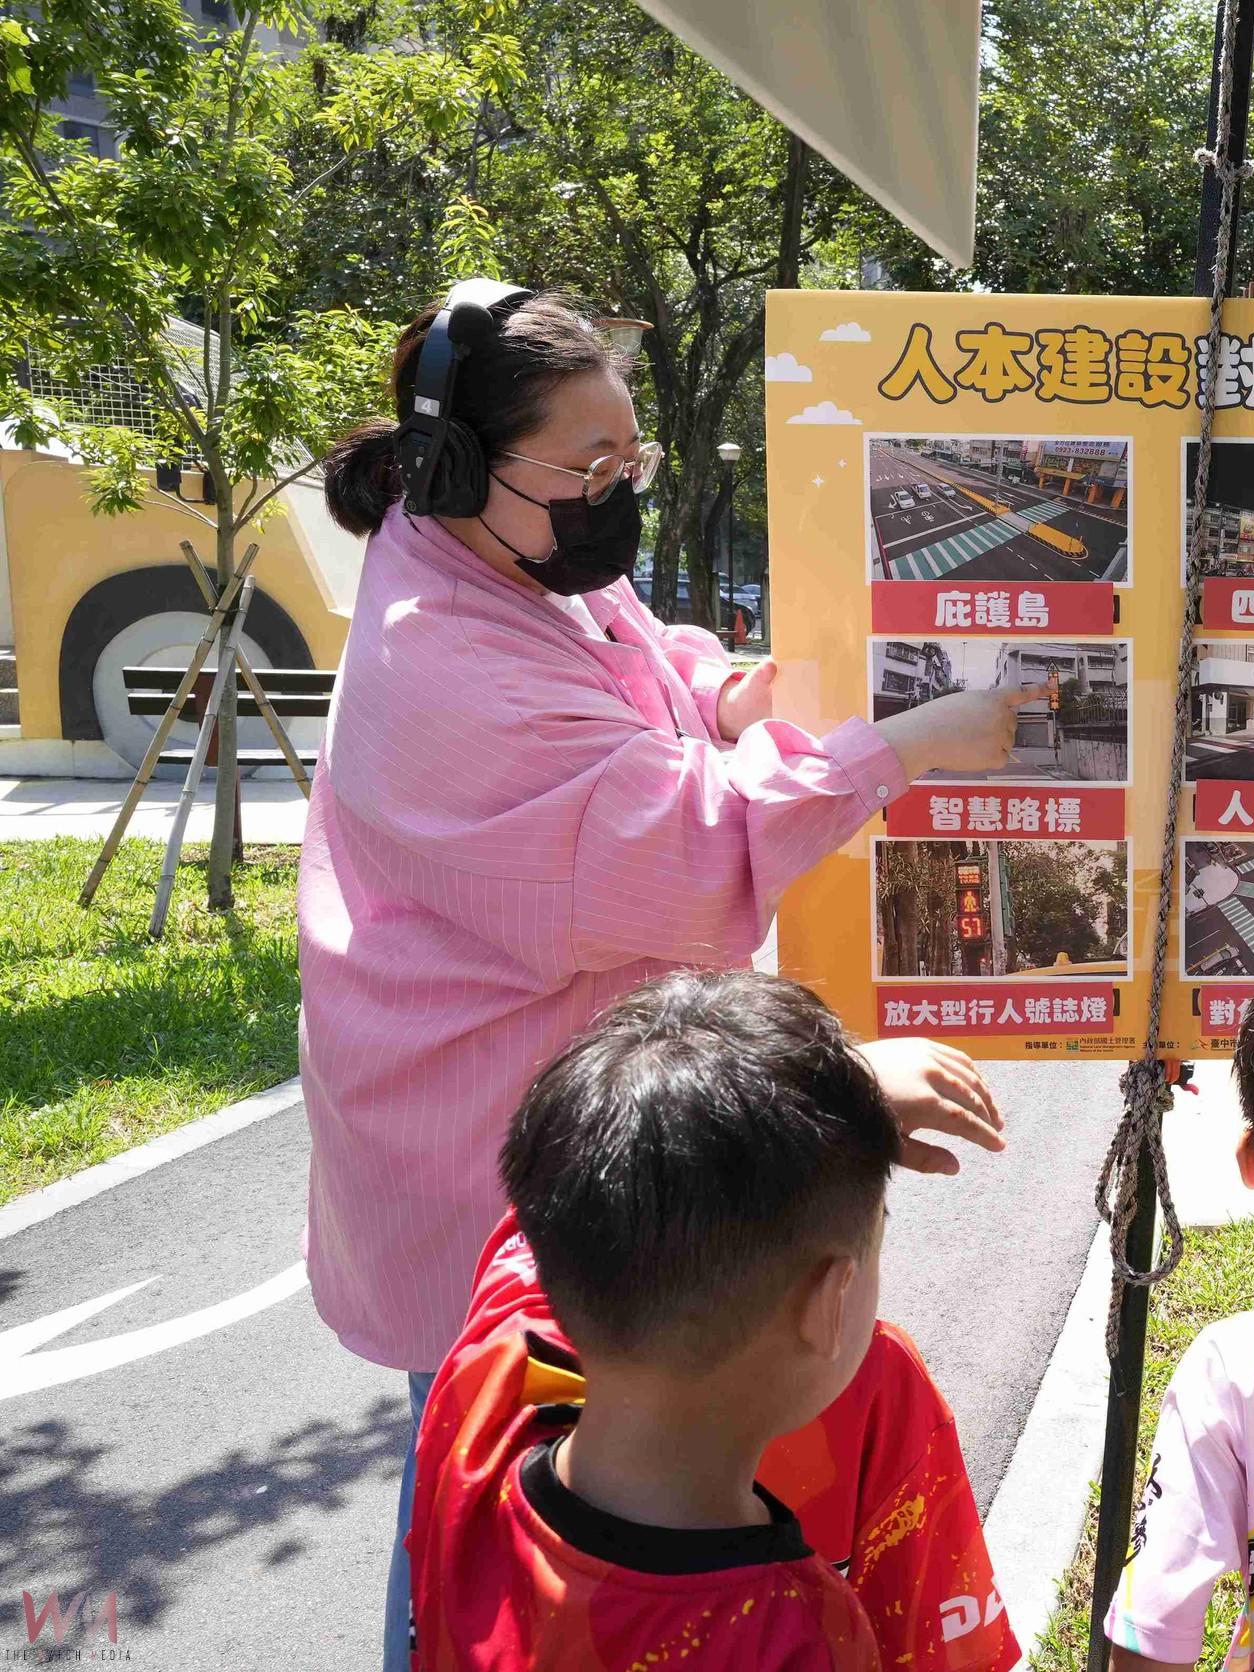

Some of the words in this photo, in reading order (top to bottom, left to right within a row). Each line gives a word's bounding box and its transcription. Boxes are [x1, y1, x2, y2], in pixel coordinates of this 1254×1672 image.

[421, 399, 433, 413] 4
[934, 591, 1050, 630] 庇護島
[928, 795, 1082, 835] 智慧路標
[884, 996, 1108, 1028] 放大型行人號誌燈
[1025, 1040, 1063, 1050] 指導單位：
